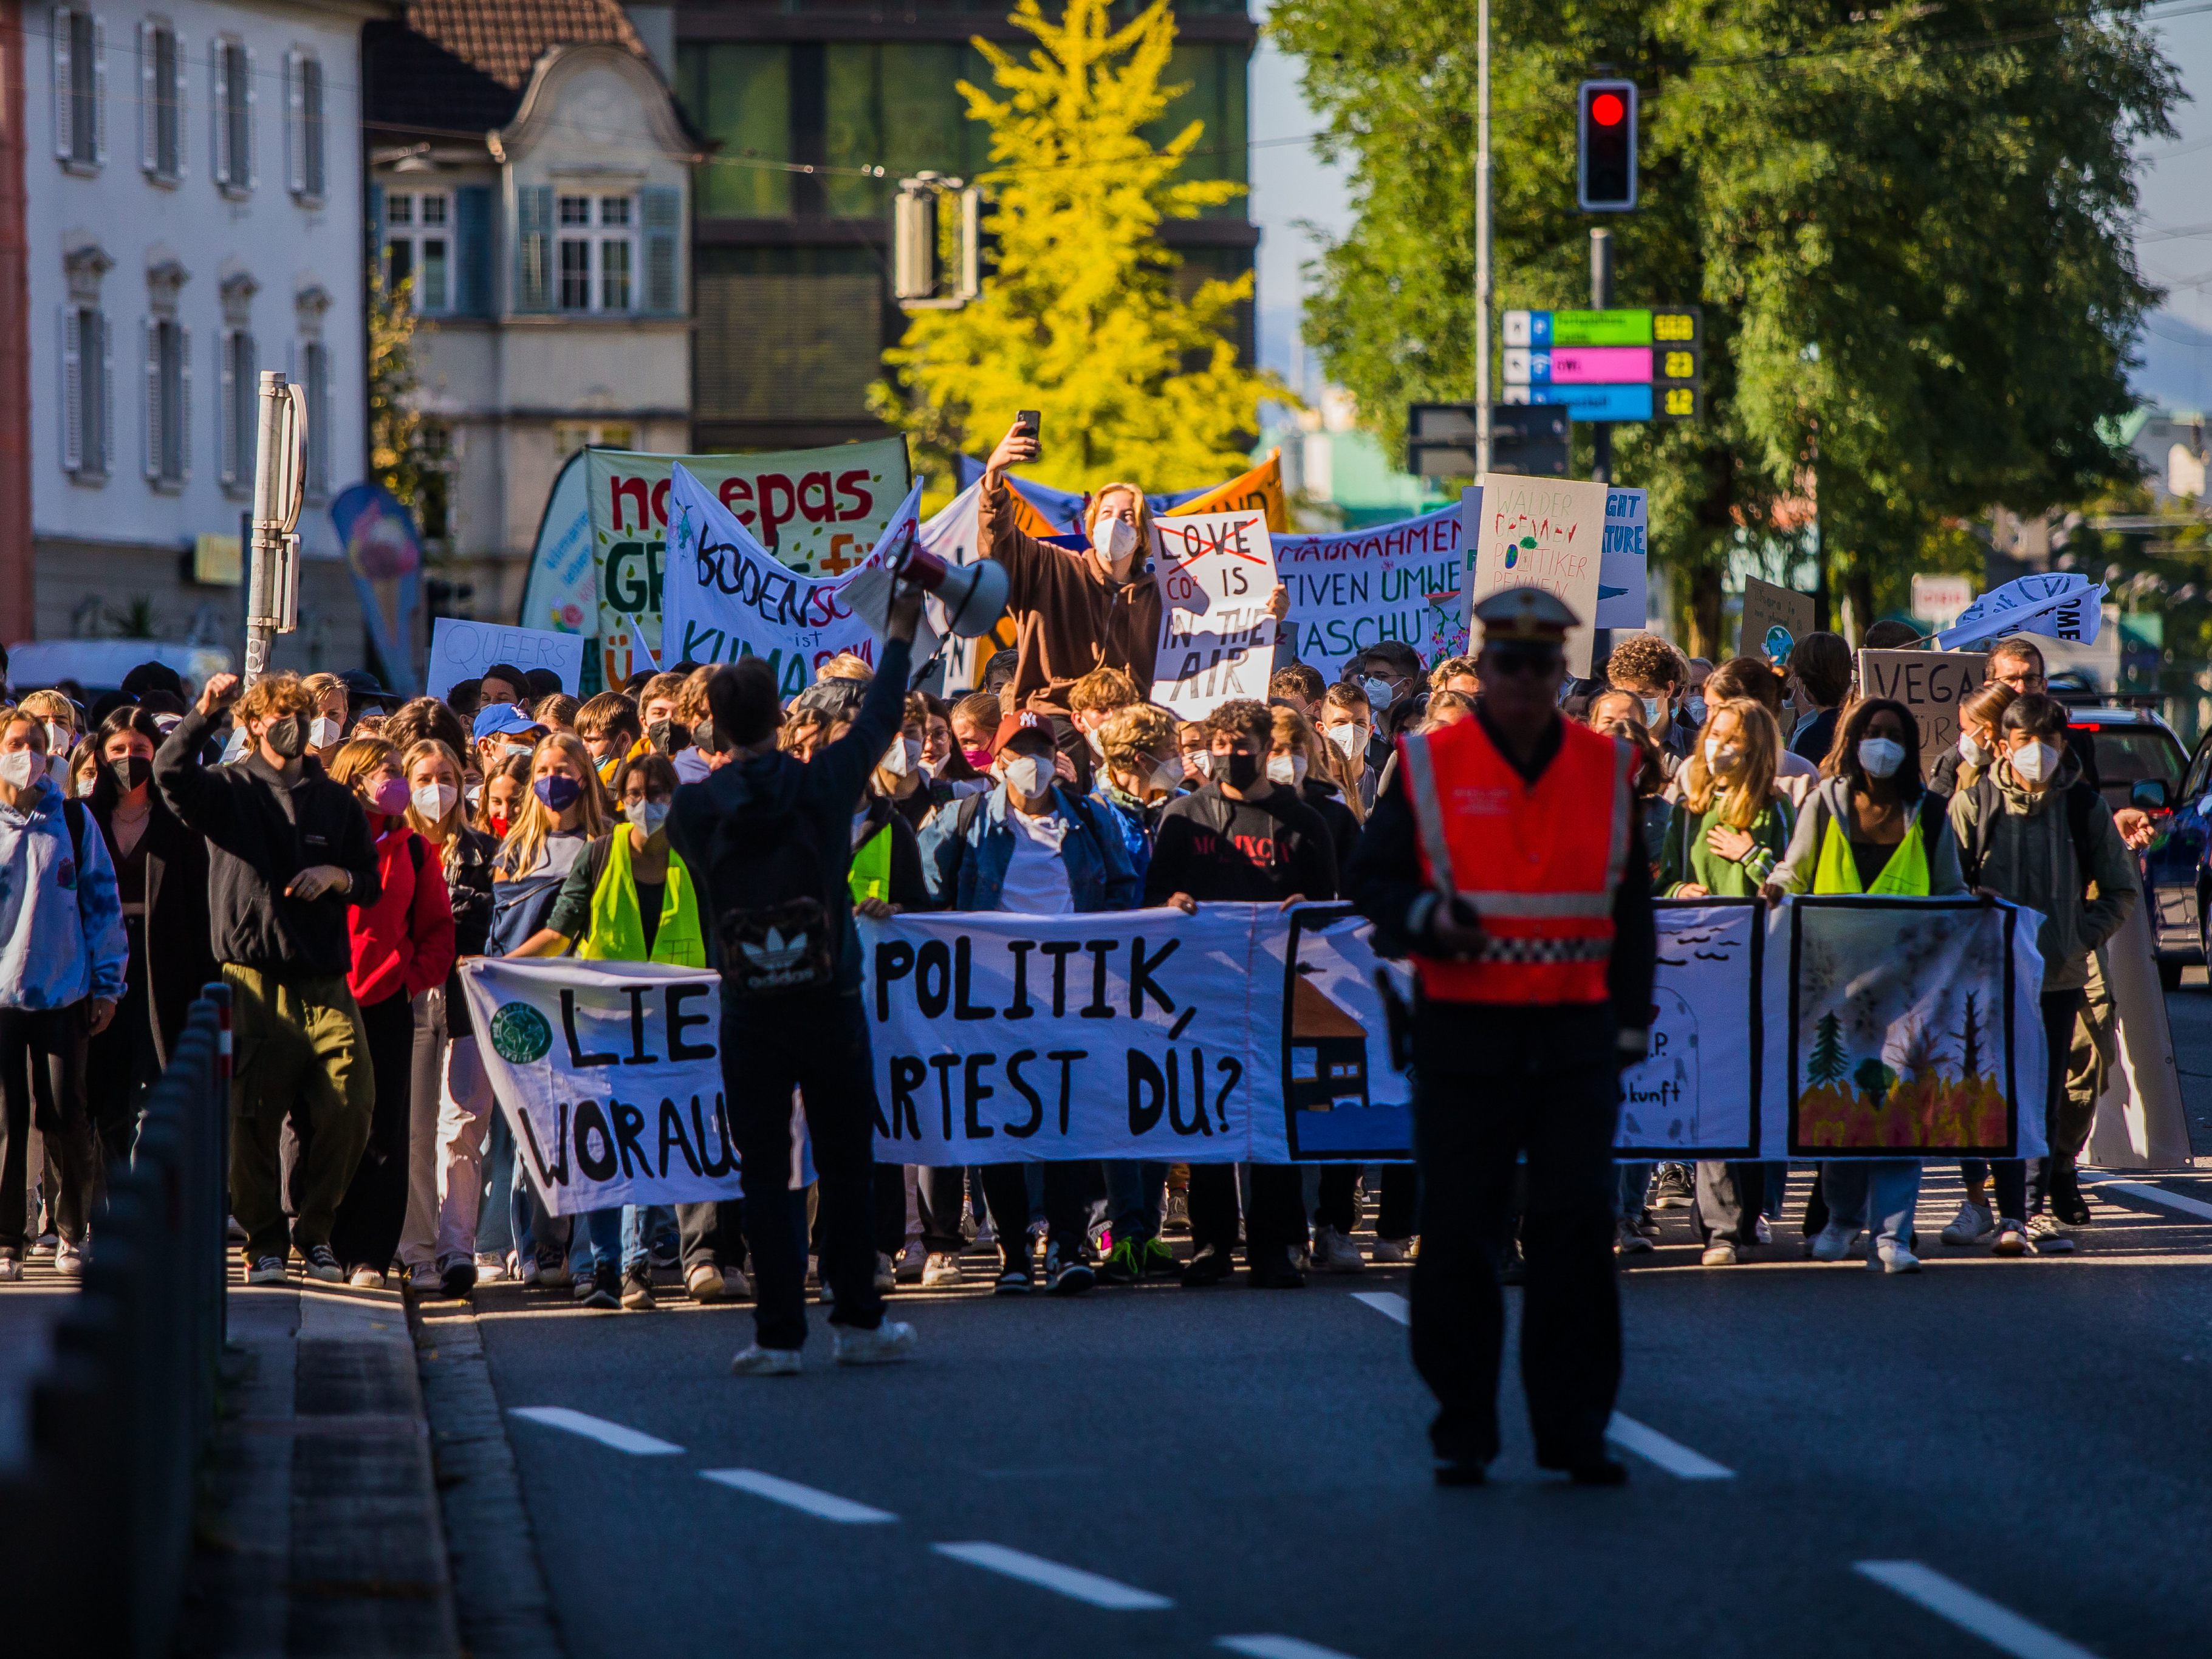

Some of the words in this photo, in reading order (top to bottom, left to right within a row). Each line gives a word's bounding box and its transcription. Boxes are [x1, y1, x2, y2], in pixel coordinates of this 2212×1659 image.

[719, 468, 874, 547] epas
[1495, 513, 1578, 544] BRENNEN
[1157, 521, 1252, 560] LOVE
[1601, 525, 1645, 555] TURE
[1222, 566, 1249, 597] IS
[444, 624, 570, 672] QUEERS
[795, 631, 822, 648] ist
[1163, 612, 1194, 650] IN
[1216, 608, 1268, 648] THE
[1169, 646, 1250, 702] AIR
[875, 936, 1197, 1040] POLITIK,
[1127, 1047, 1242, 1137] DU?
